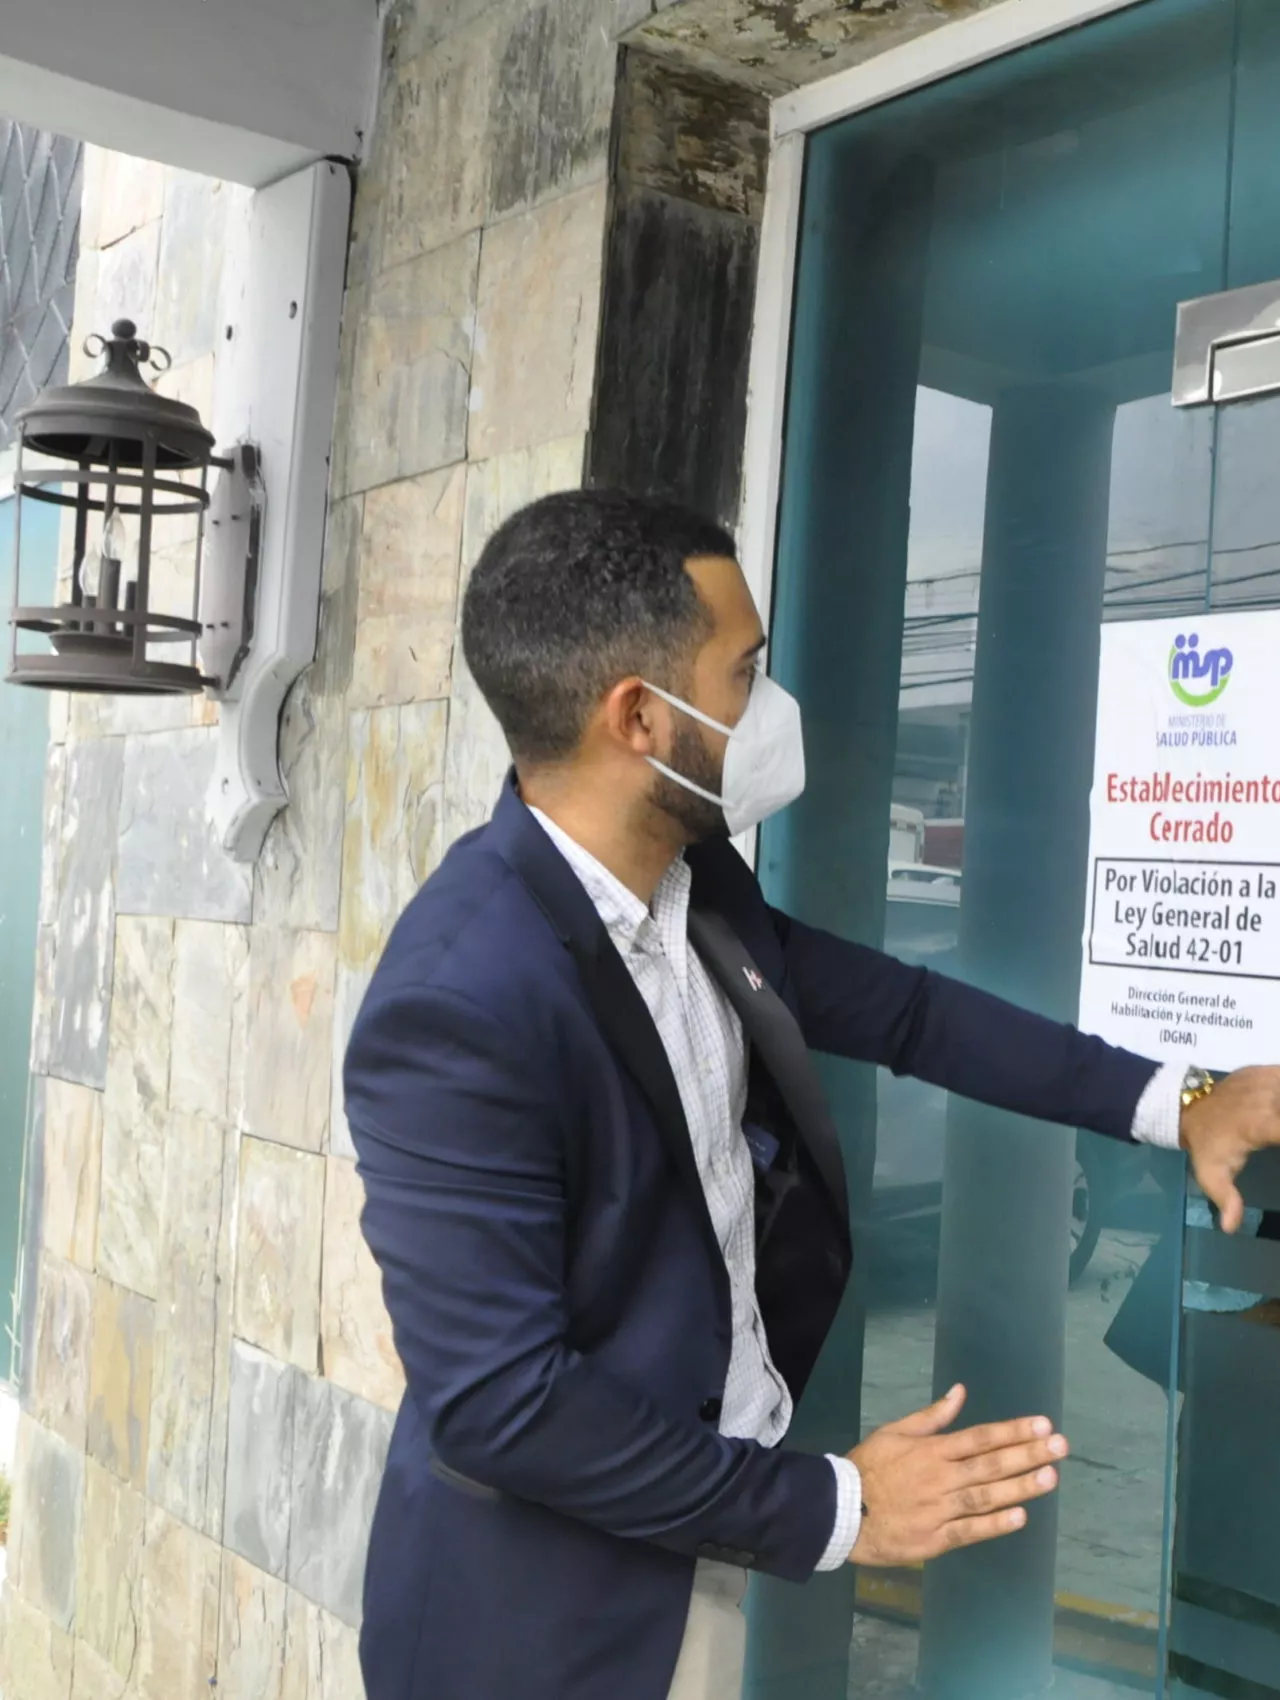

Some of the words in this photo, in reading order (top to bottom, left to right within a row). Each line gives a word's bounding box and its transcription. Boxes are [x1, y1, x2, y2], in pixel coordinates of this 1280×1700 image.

[1168, 714, 1214, 728] MINISTERIO
[1156, 731, 1189, 747] SALUD
[1191, 730, 1237, 747] PÚBLICA
[1149, 812, 1233, 844] Cerrado
[1105, 868, 1137, 894] Por
[1141, 869, 1233, 897] Violación
[1238, 877, 1251, 897] a
[1256, 875, 1276, 899] la
[1114, 899, 1146, 931] Ley
[1151, 903, 1229, 931] General
[1235, 906, 1262, 933] de
[1125, 933, 1180, 960] Salud
[1185, 938, 1243, 965] 42-01
[1128, 986, 1175, 1004] Dirección
[1178, 991, 1220, 1008] General
[1222, 996, 1236, 1009] de
[1176, 1012, 1182, 1024] y
[1184, 1011, 1253, 1029] Acreditación
[1159, 1029, 1197, 1047] (DGHA)
